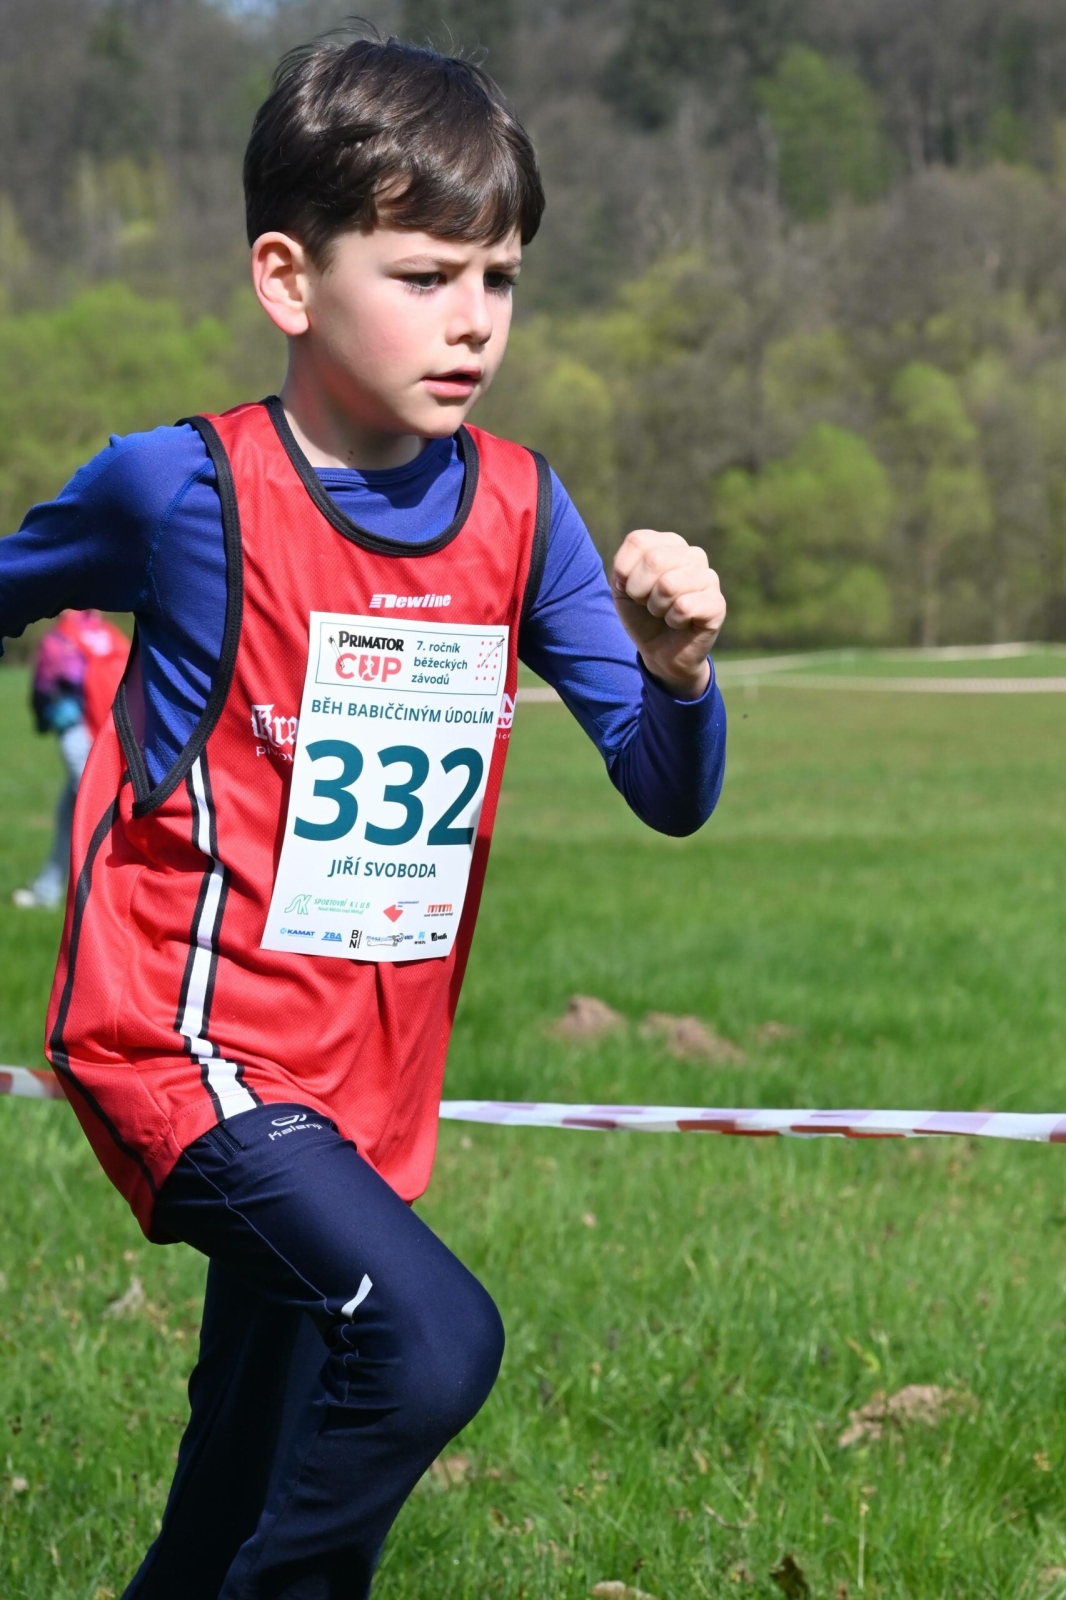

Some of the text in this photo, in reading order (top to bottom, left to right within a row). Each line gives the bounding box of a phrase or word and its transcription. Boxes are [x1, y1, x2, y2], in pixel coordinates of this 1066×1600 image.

[338, 630, 404, 652] PRIMATOR
[416, 640, 461, 654] 7. ročník
[335, 652, 402, 683] CUP
[414, 655, 468, 670] běžeckých
[411, 673, 450, 685] závodů
[311, 698, 494, 725] BĚH BABIČČINÝM ÚDOLÍM
[293, 739, 484, 846] 332
[327, 855, 437, 879] JIŘÍ SVOBODA
